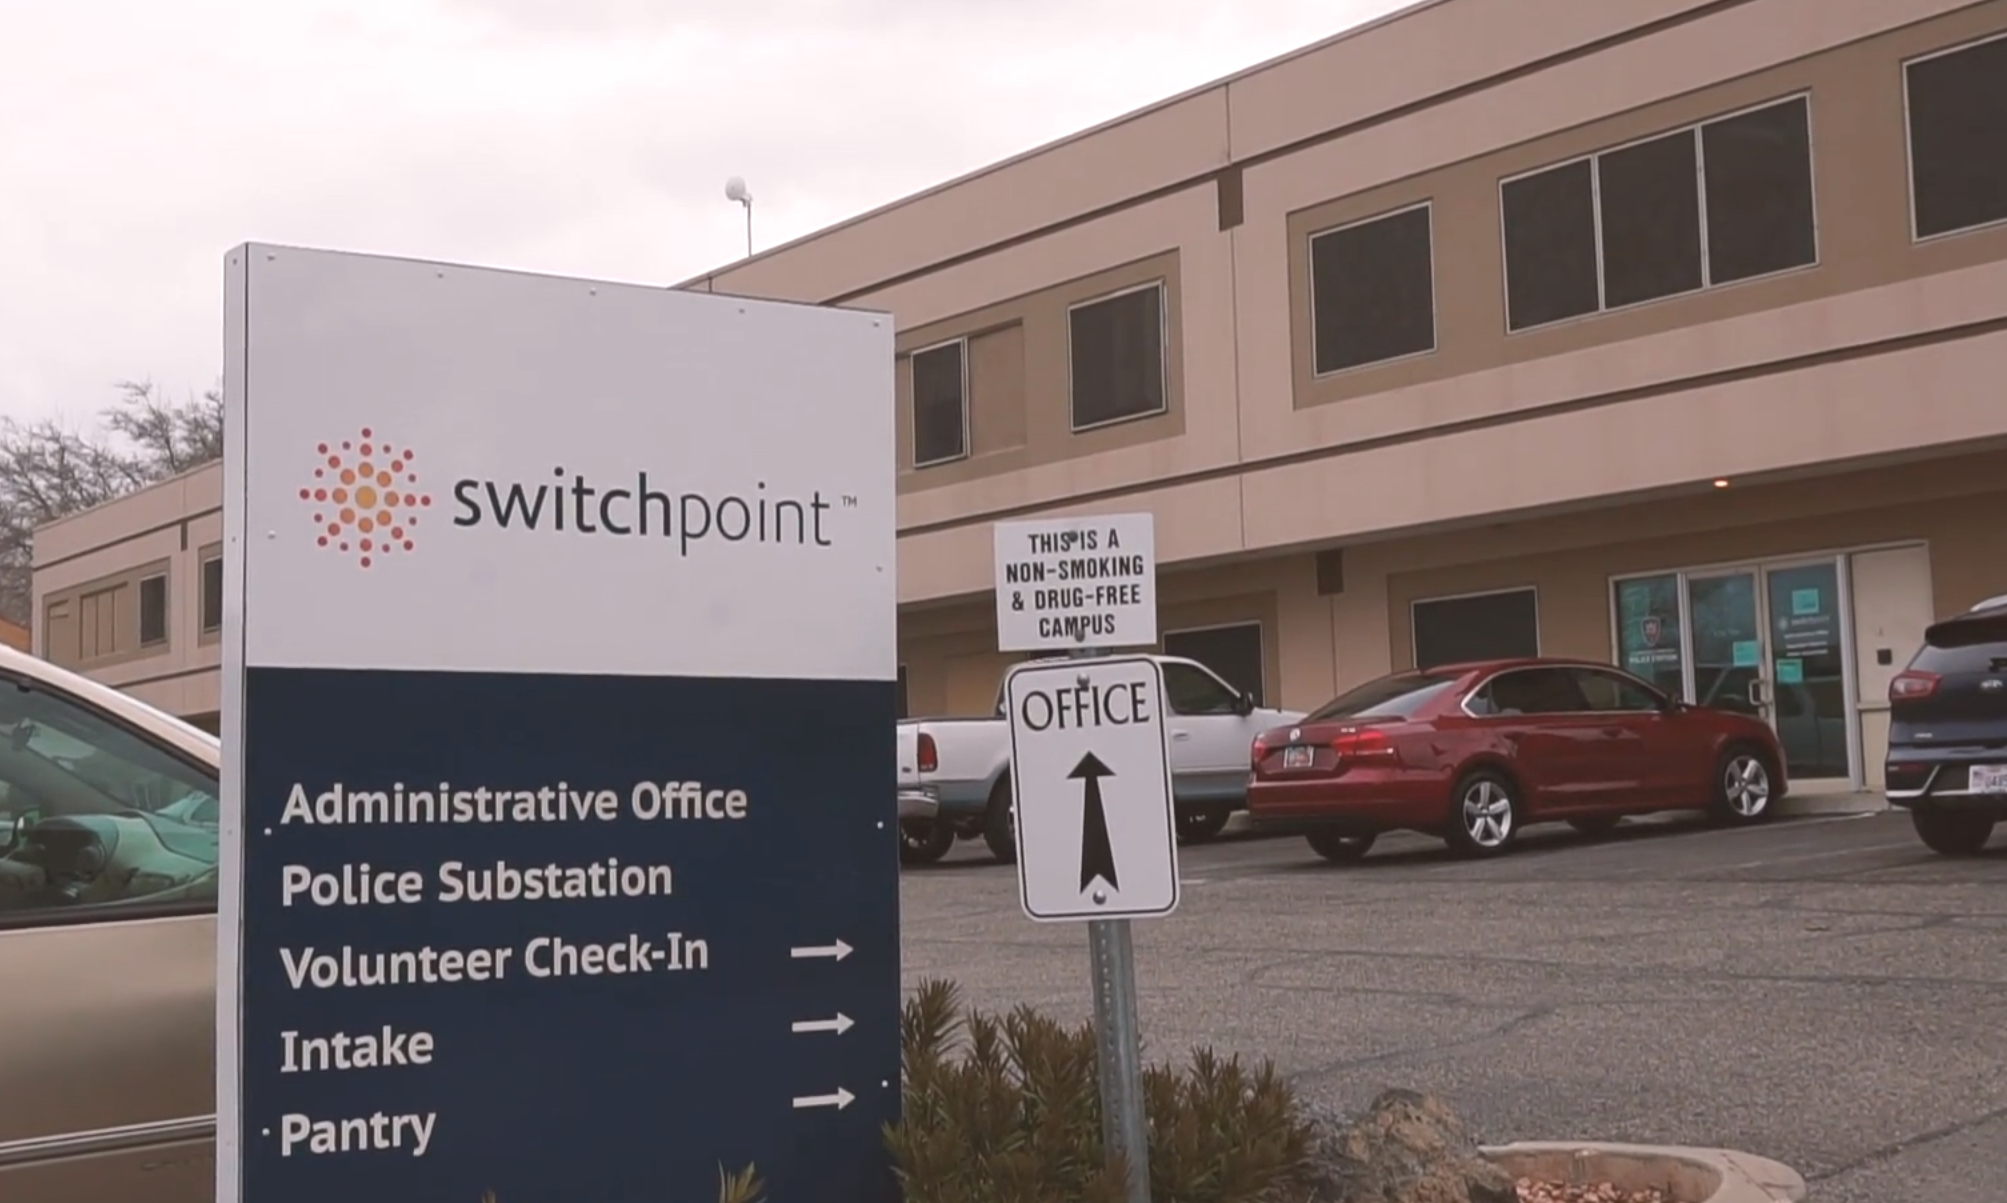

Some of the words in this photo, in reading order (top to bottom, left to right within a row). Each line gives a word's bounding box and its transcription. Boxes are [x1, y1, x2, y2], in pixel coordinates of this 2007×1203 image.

[453, 466, 832, 557] switchpoint
[1028, 531, 1072, 554] THIS
[1080, 530, 1098, 550] IS
[1108, 528, 1120, 549] A
[1006, 555, 1144, 583] NON-SMOKING
[1012, 591, 1024, 611] &
[1035, 584, 1141, 610] DRUG-FREE
[1039, 614, 1115, 638] CAMPUS
[1022, 682, 1150, 731] OFFICE
[280, 782, 618, 825] Administrative
[631, 781, 748, 820] Office
[282, 863, 423, 906] Police
[438, 858, 673, 902] Substation
[279, 945, 513, 989] Volunteer
[524, 932, 709, 976] Check-In
[280, 1025, 434, 1073] Intake
[281, 1111, 436, 1156] Pantry
